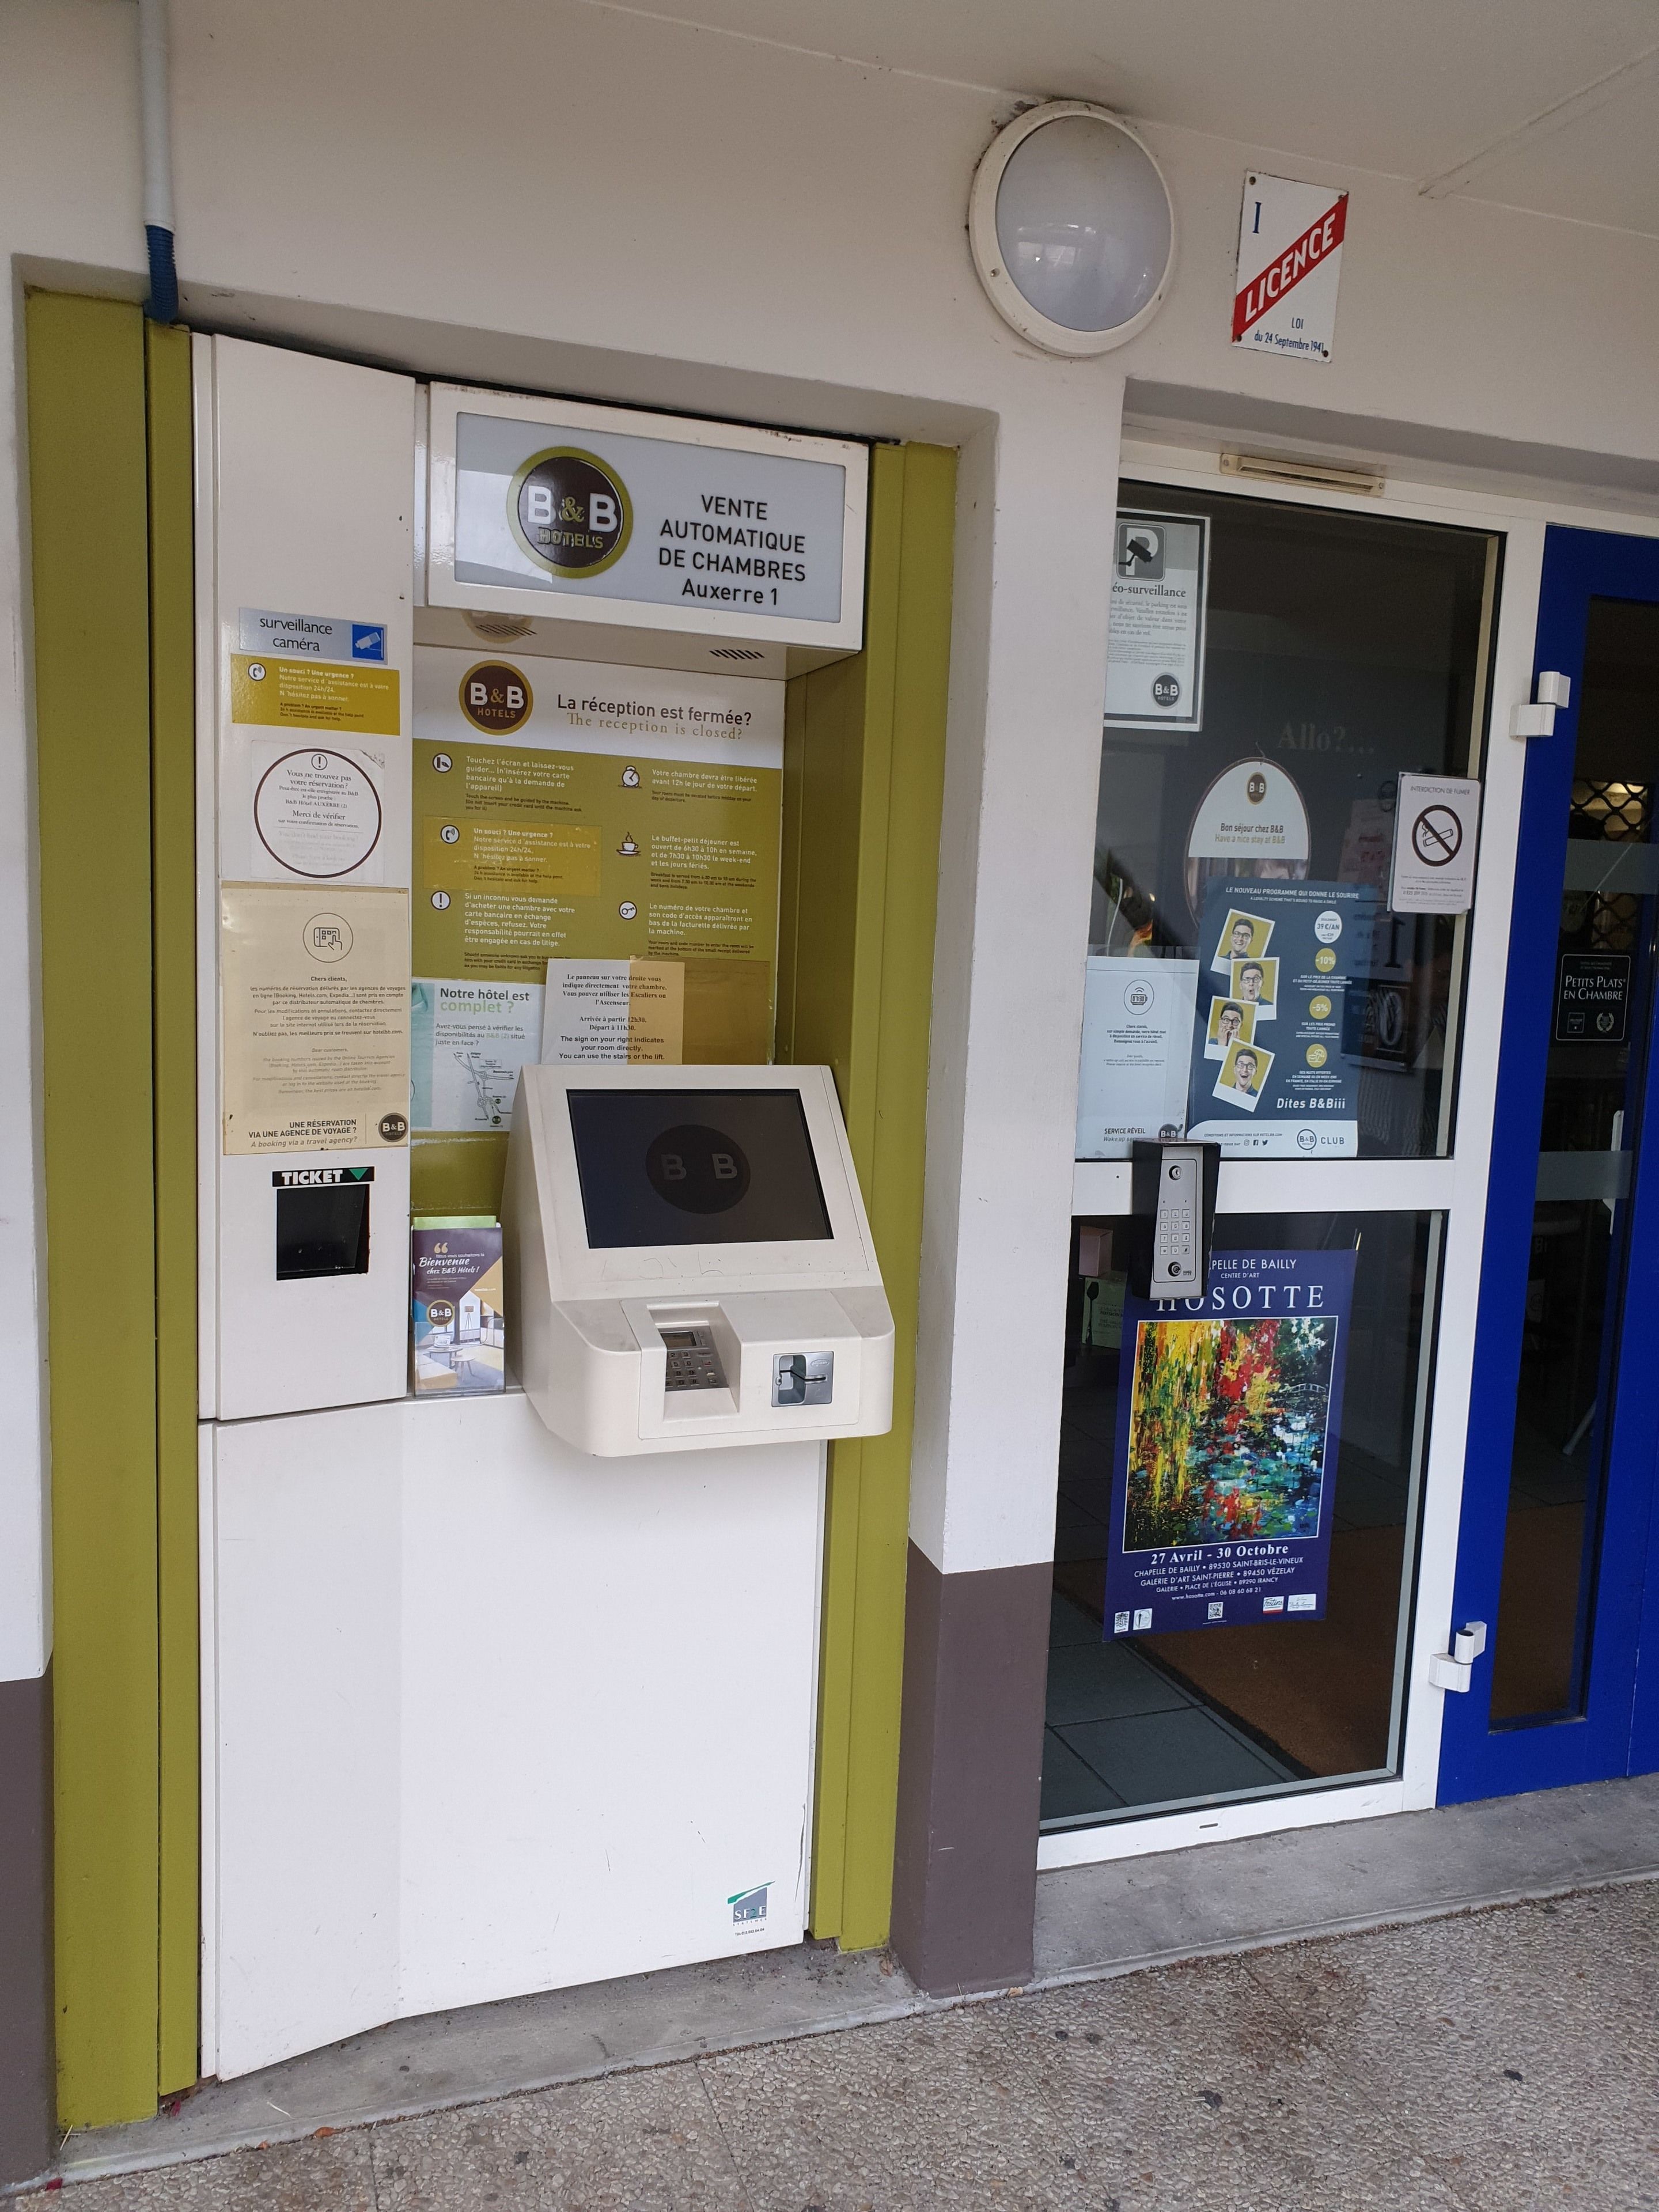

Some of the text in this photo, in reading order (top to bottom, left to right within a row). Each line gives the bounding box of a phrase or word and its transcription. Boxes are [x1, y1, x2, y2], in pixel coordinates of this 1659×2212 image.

[1245, 213, 1336, 322] LICENCE
[1291, 317, 1304, 329] LOI
[1254, 330, 1263, 342] du
[1265, 333, 1272, 344] 24
[1274, 334, 1309, 350] Septembre
[527, 485, 618, 532] B&B
[702, 494, 767, 521] VENTE
[537, 527, 604, 550] HOTELS
[660, 519, 806, 554] AUTOMATIQUE
[659, 547, 806, 582] DE CHAMBRES
[681, 579, 778, 605] Auxerre 1
[1112, 582, 1186, 597] éo-surveillance
[259, 618, 332, 635] surveillance
[273, 637, 320, 652] caméra
[470, 682, 524, 709] B&B
[1155, 683, 1178, 696] B&B
[478, 707, 516, 719] HOTELS
[558, 694, 752, 725] La réception est fermée?
[567, 713, 743, 740] The reception is closed?
[467, 756, 495, 764] Touchez
[497, 759, 521, 767] l'écran
[532, 762, 574, 771] laissez-vous
[1410, 786, 1445, 794] INTERDICTION
[293, 810, 346, 820] Merci de vérifier
[1221, 823, 1283, 834] Bon séjour chez B&B
[440, 988, 529, 1001] Notre hôtel est
[441, 1000, 514, 1014] complet ?
[1277, 1098, 1345, 1109] Dites B&Biii
[382, 1122, 406, 1132] B&B
[328, 1136, 357, 1144] agency?
[281, 1169, 343, 1185] TICKET
[419, 1257, 469, 1267] Bienvenue
[1209, 1259, 1297, 1270] PELLE DE BAILLY
[431, 1308, 452, 1317] B&B
[1151, 1553, 1166, 1565] 27
[1169, 1550, 1202, 1563] Avril
[1217, 1547, 1231, 1558] 30
[1236, 1544, 1289, 1556] Octobre
[1134, 1566, 1166, 1577] CHAPELLE
[1180, 1565, 1200, 1573] BAILLY
[1209, 1562, 1230, 1570] 89530
[1232, 1557, 1304, 1567] SAINT-BRIS-LE-VINEUX
[1141, 1566, 1296, 1586] GALERIE D'ART SAINT-PIERRE 89450 VÉZELAY
